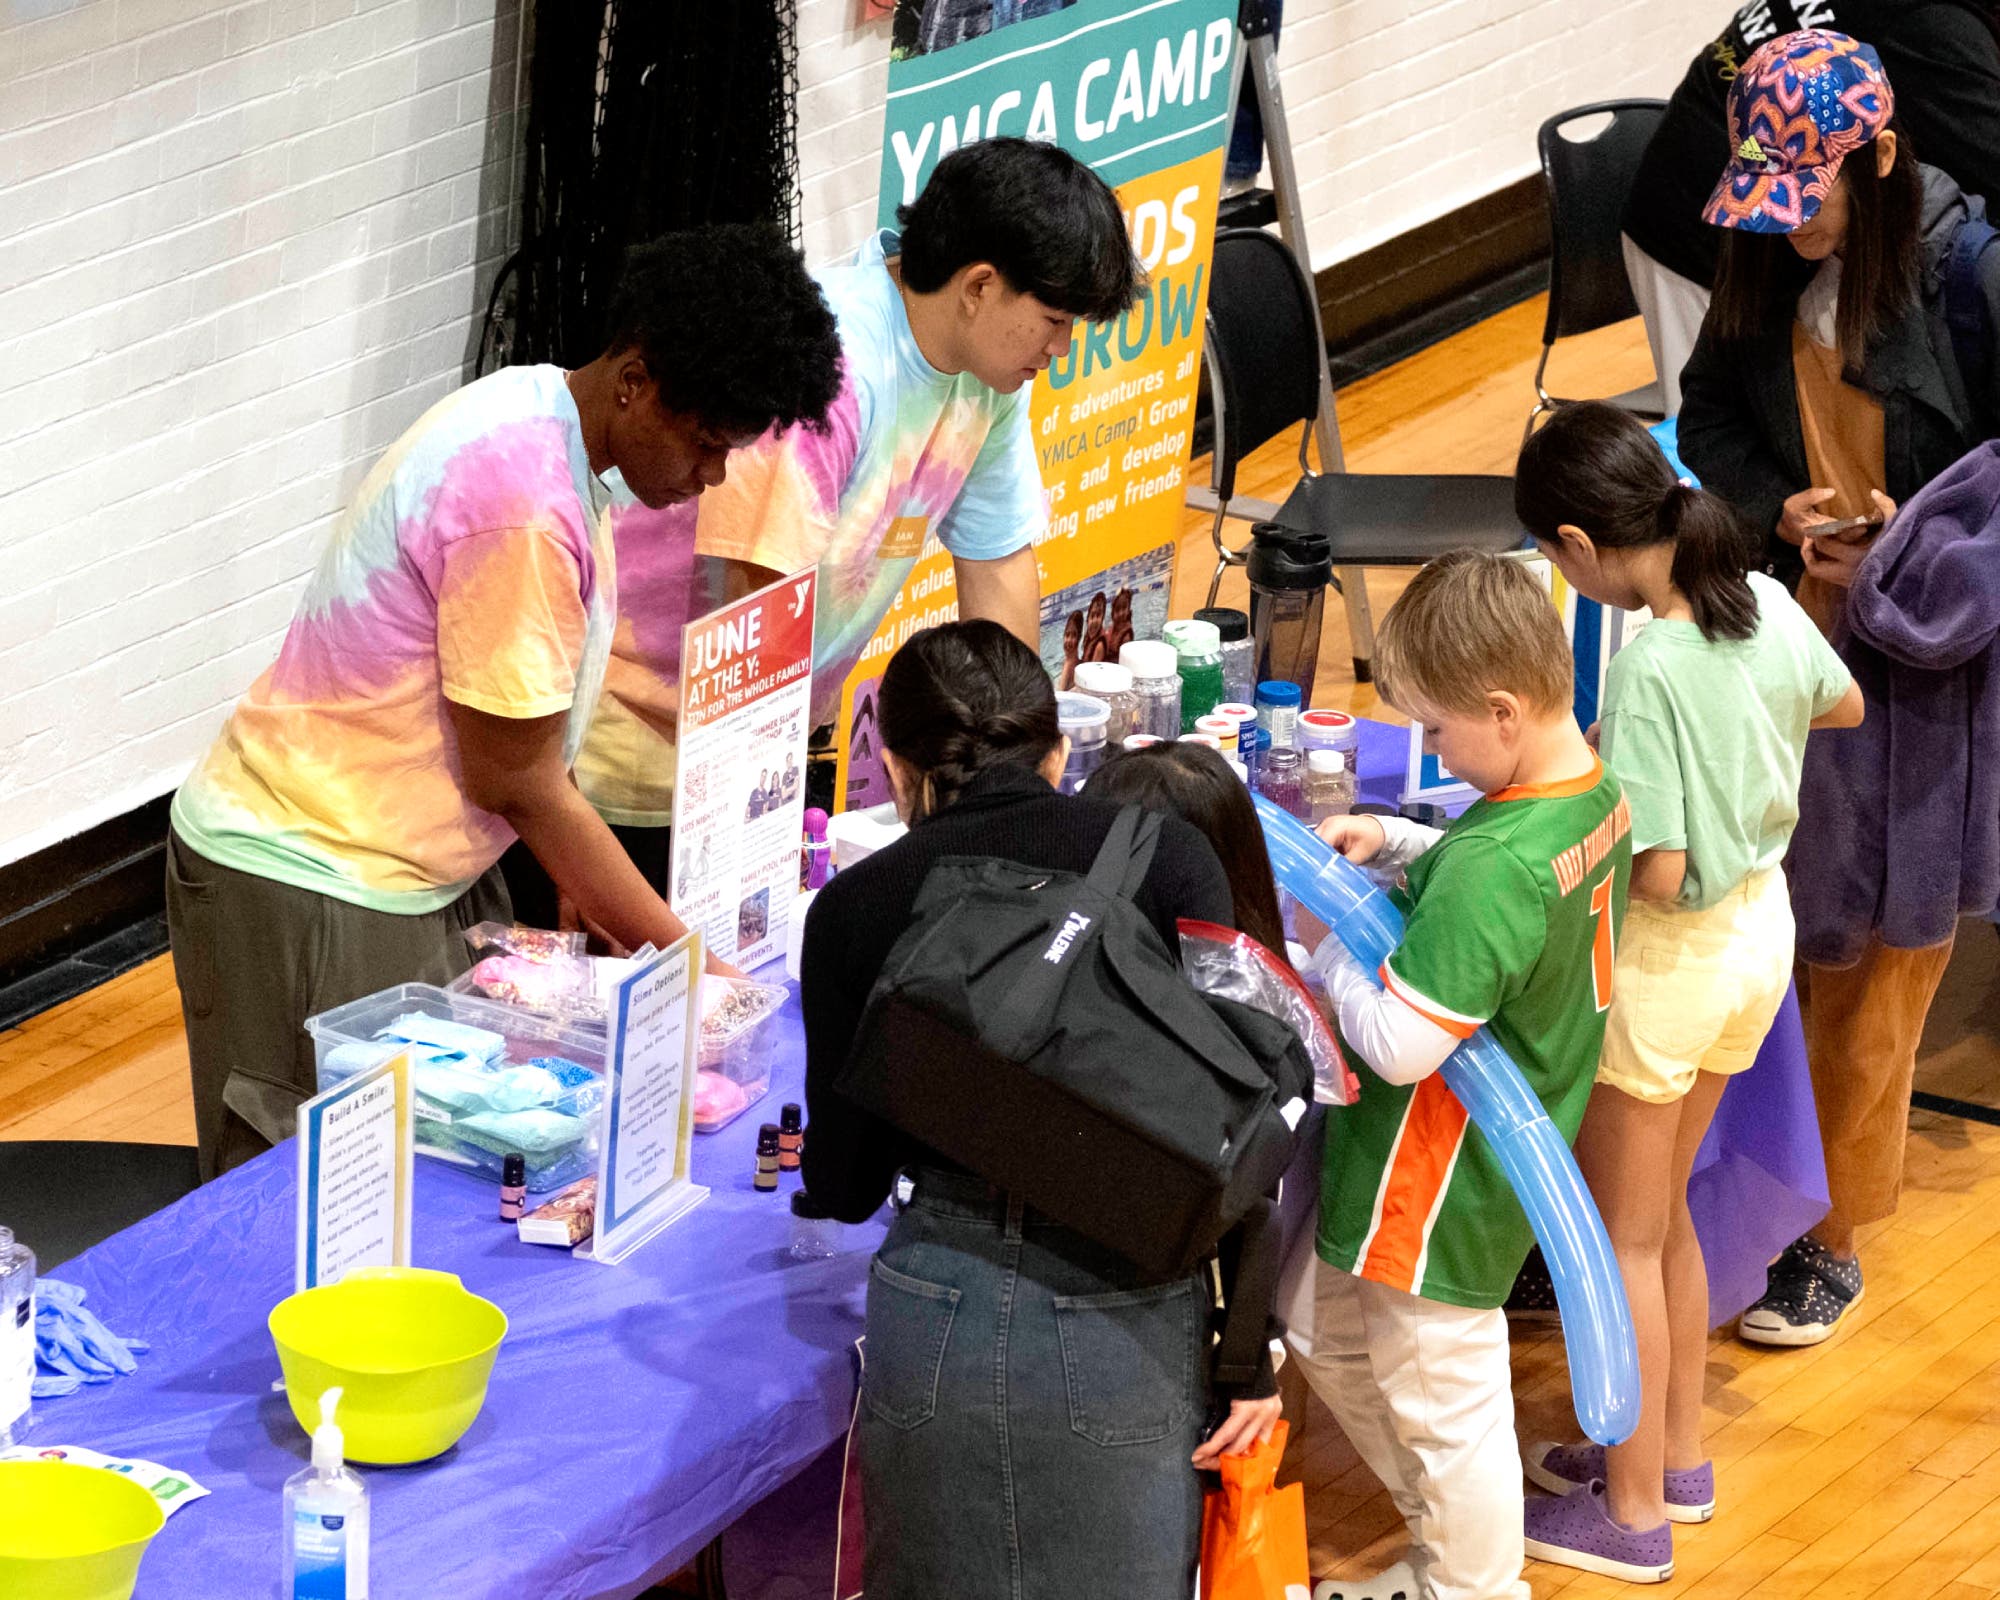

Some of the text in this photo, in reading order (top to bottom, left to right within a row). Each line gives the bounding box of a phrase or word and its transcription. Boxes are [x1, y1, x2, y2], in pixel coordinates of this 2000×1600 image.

[892, 17, 1232, 206] YMCA CAMP
[1042, 351, 1194, 436] of adventures all
[1042, 394, 1190, 470] YMCA Camp! Grow
[1080, 456, 1110, 491] and
[1122, 431, 1185, 472] develop
[1032, 464, 1181, 548] aking new friends
[911, 566, 957, 602] value
[690, 606, 762, 677] JUNE
[860, 625, 895, 661] and
[688, 654, 760, 708] AT THE Y:
[707, 699, 724, 718] FOR
[726, 687, 744, 708] THE
[744, 676, 775, 699] WHOLE
[776, 657, 809, 684] FAMILY!
[1590, 866, 1615, 1013] 1
[633, 987, 653, 1006] Slime
[654, 963, 686, 992] Options!
[329, 1103, 351, 1125] Build
[354, 1099, 360, 1110] A
